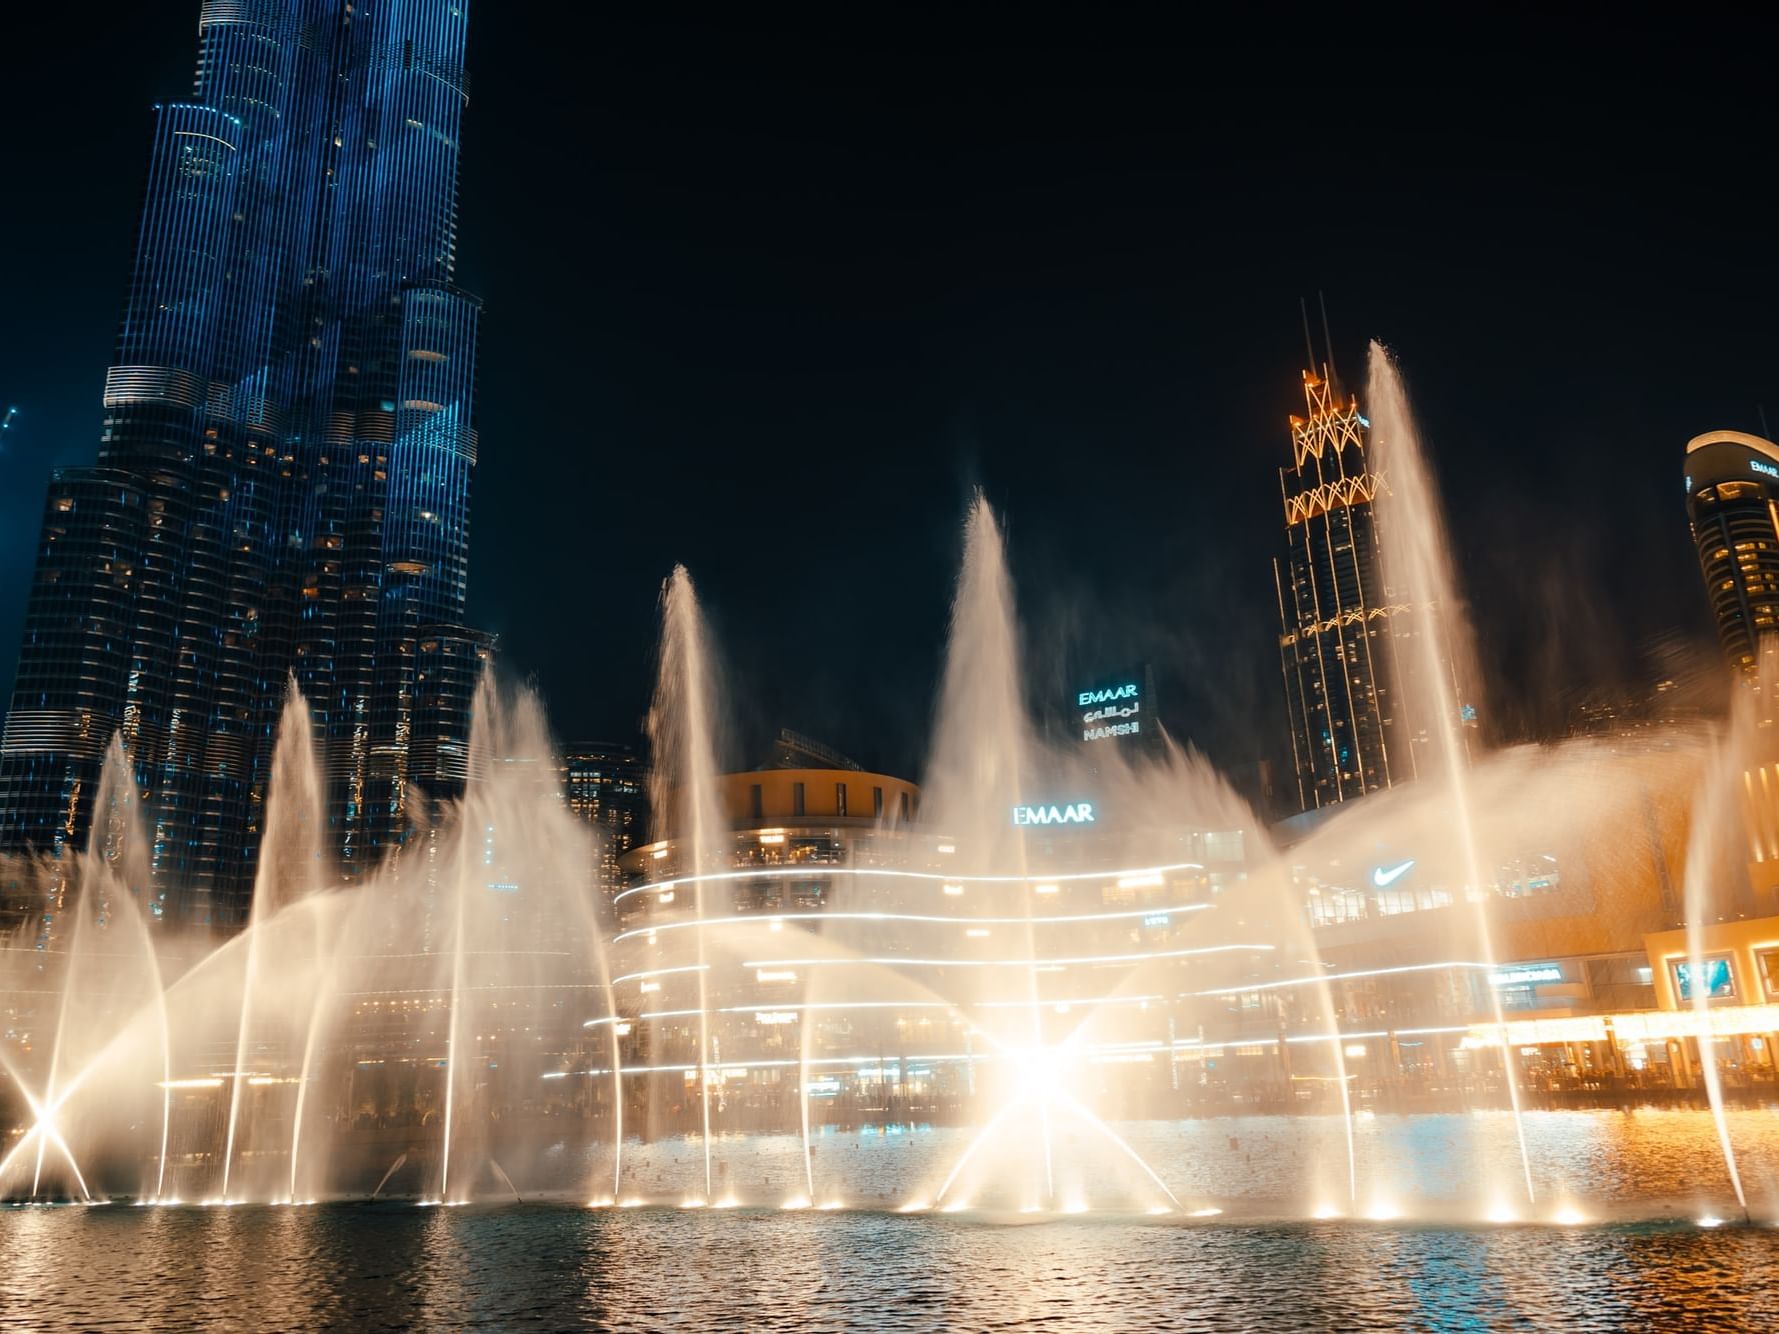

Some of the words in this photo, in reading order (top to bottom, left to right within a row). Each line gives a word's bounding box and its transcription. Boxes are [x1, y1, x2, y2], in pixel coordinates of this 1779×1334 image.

[1079, 684, 1138, 705] EMAAR
[1083, 721, 1139, 741] NAMSHI
[1013, 803, 1095, 825] EMAAR
